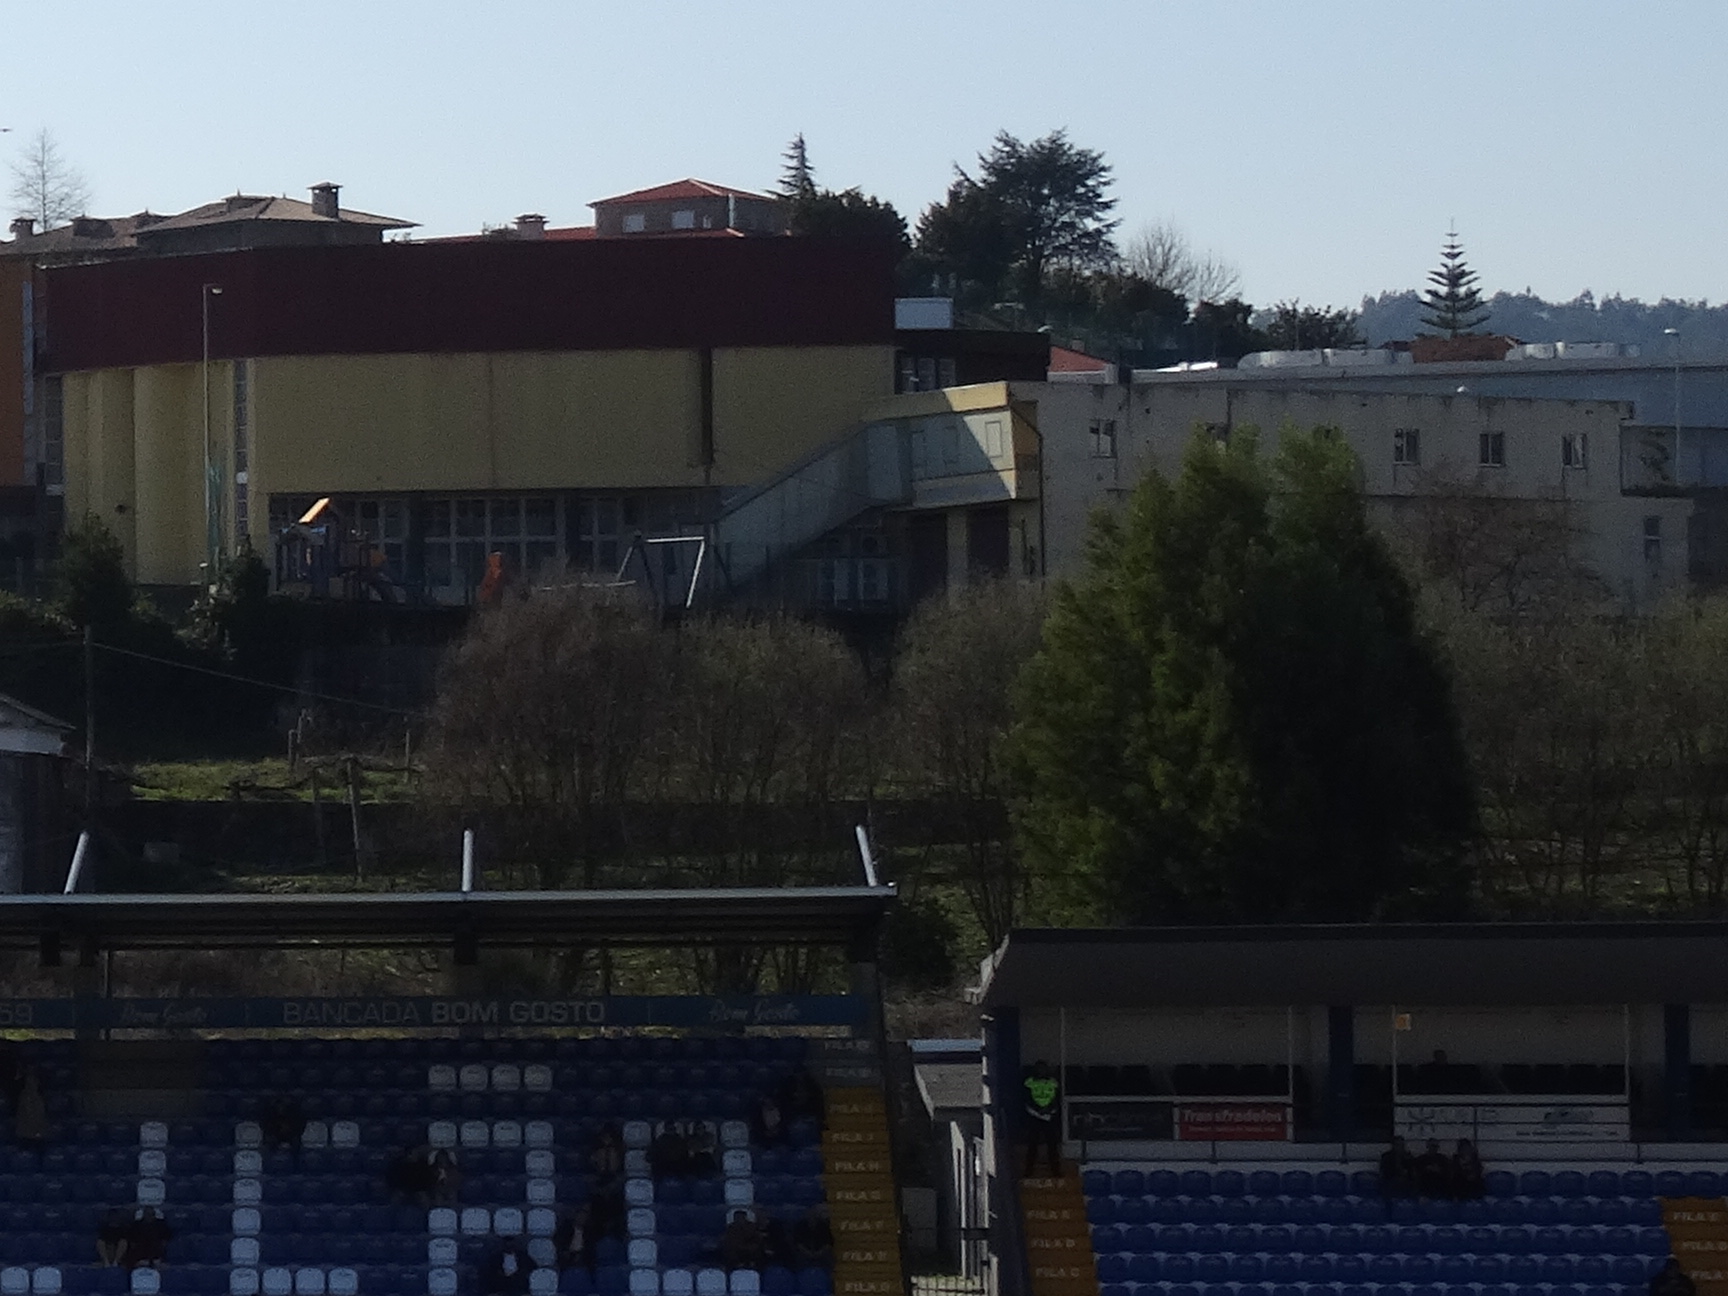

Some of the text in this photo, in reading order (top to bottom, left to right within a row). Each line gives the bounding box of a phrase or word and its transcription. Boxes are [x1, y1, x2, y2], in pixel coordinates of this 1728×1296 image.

[282, 1001, 605, 1024] BANCADA BOM GOSTO
